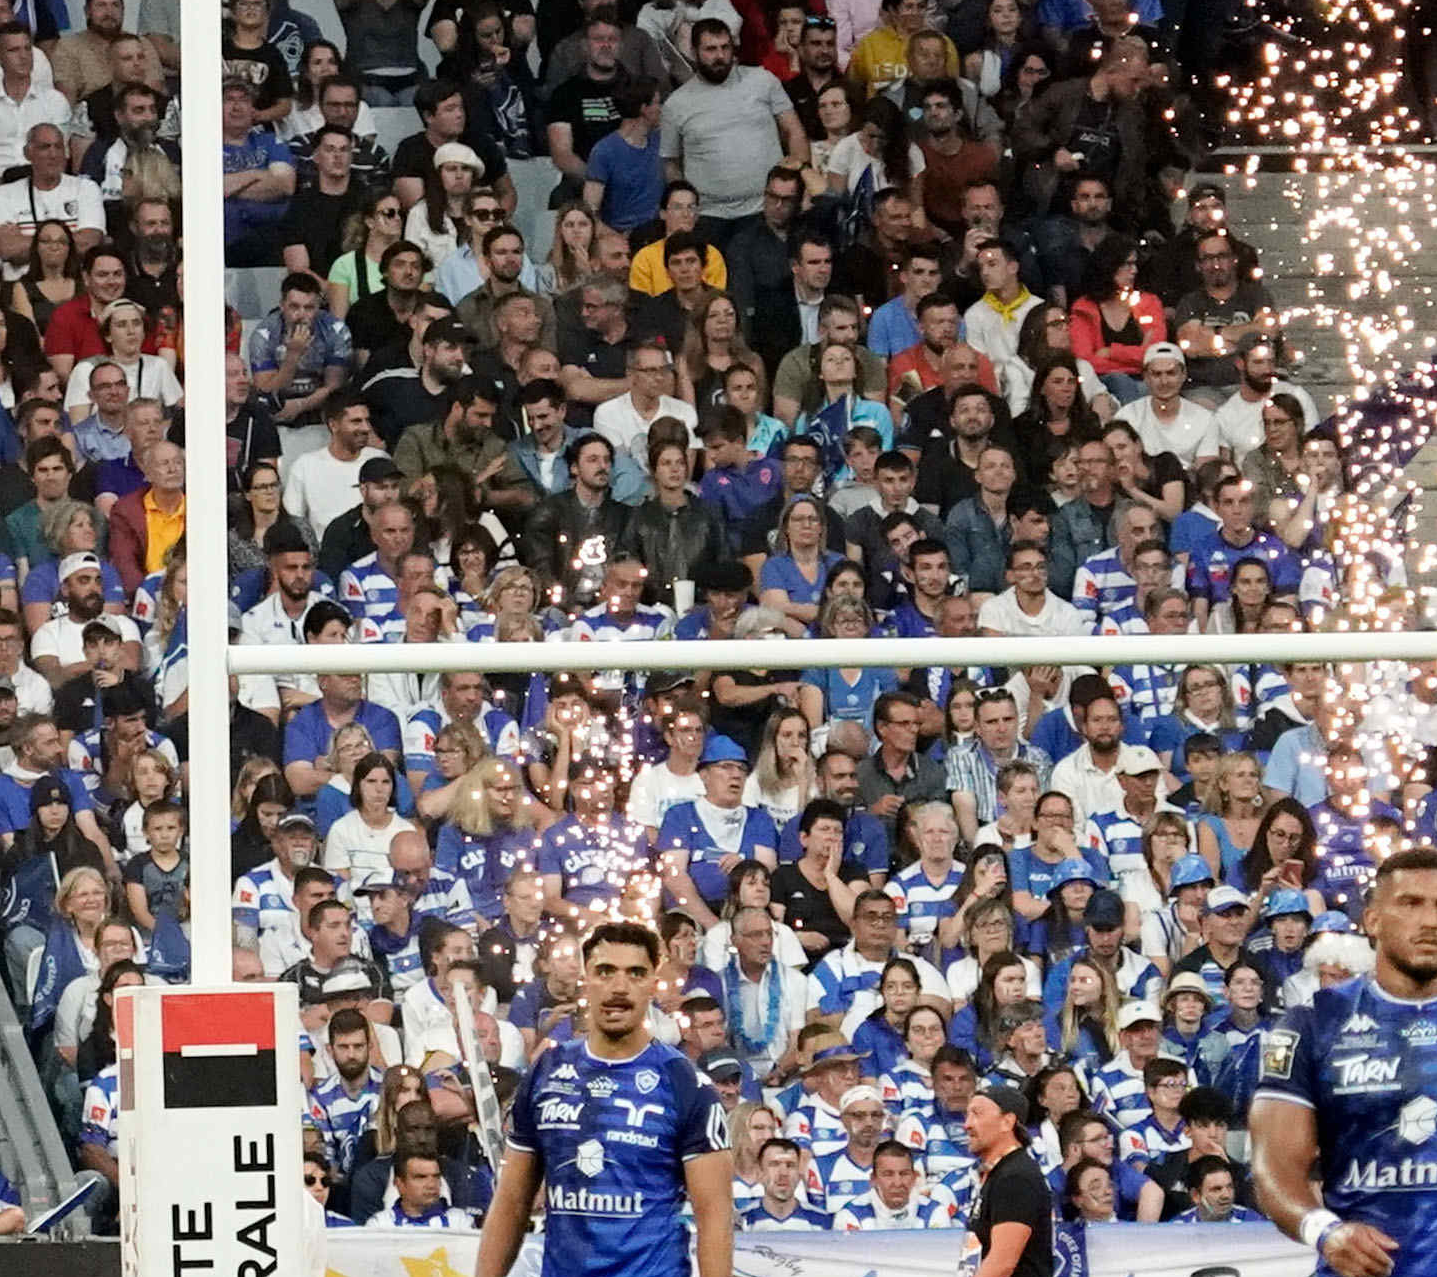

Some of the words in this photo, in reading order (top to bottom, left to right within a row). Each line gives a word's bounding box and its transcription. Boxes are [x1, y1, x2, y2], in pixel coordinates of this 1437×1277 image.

[1333, 1054, 1401, 1086] TARN
[537, 1097, 584, 1123] TARN
[606, 1129, 659, 1148] randstad
[547, 1185, 644, 1213] Matmut
